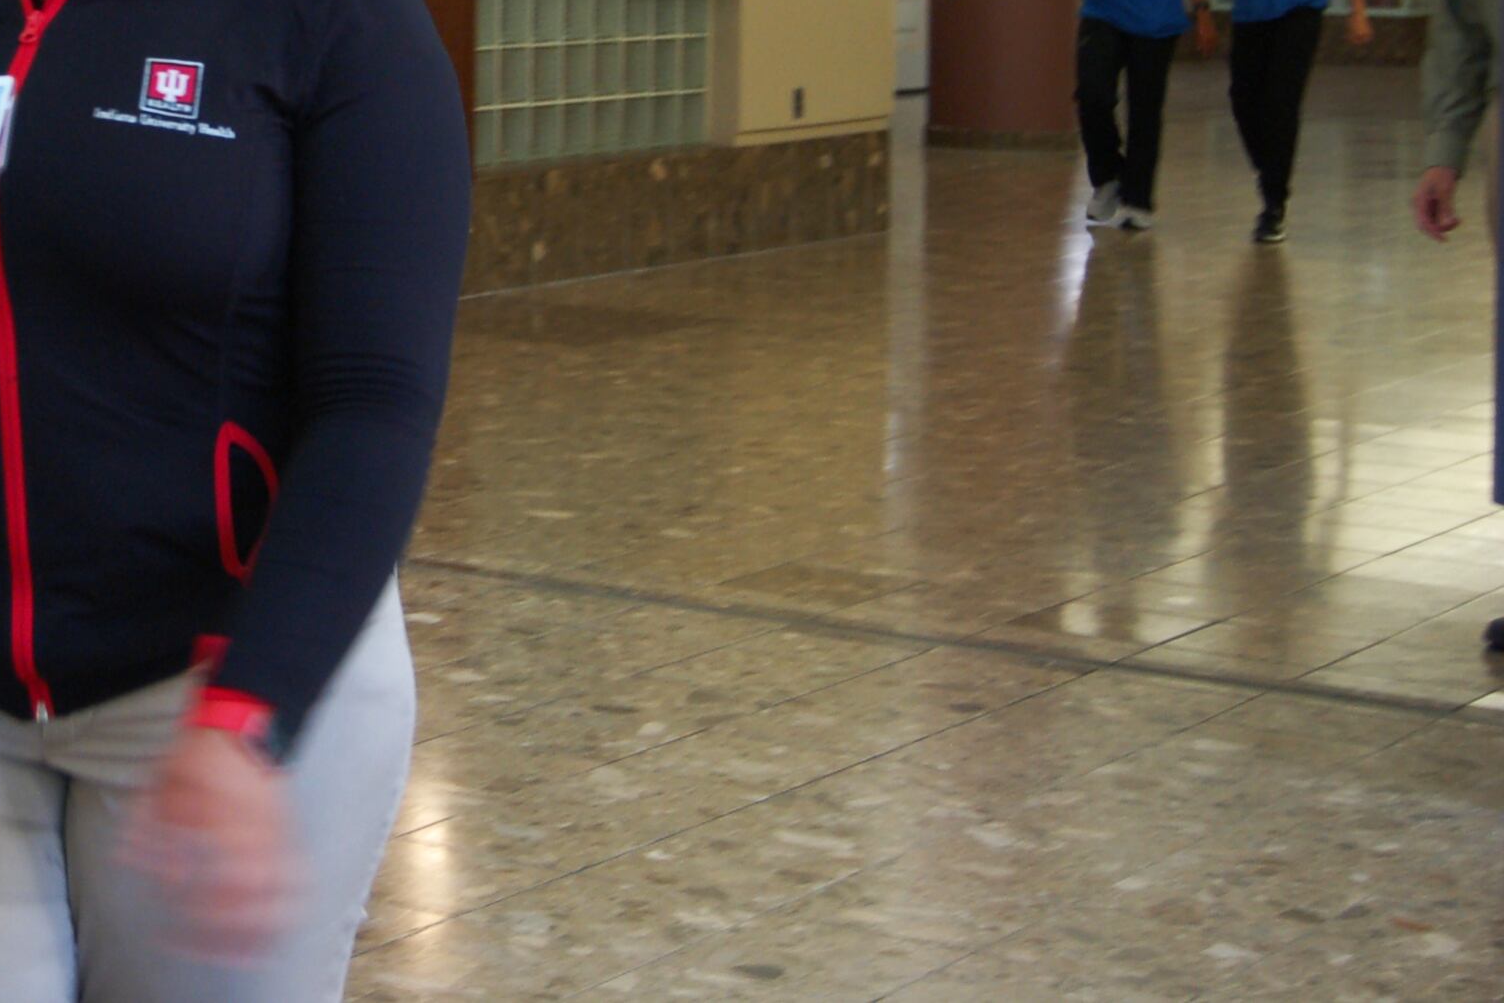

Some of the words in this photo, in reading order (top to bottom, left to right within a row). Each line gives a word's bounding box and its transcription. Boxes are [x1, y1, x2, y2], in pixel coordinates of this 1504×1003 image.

[93, 107, 138, 124] Indiana
[139, 113, 196, 136] University
[198, 121, 237, 140] Health
